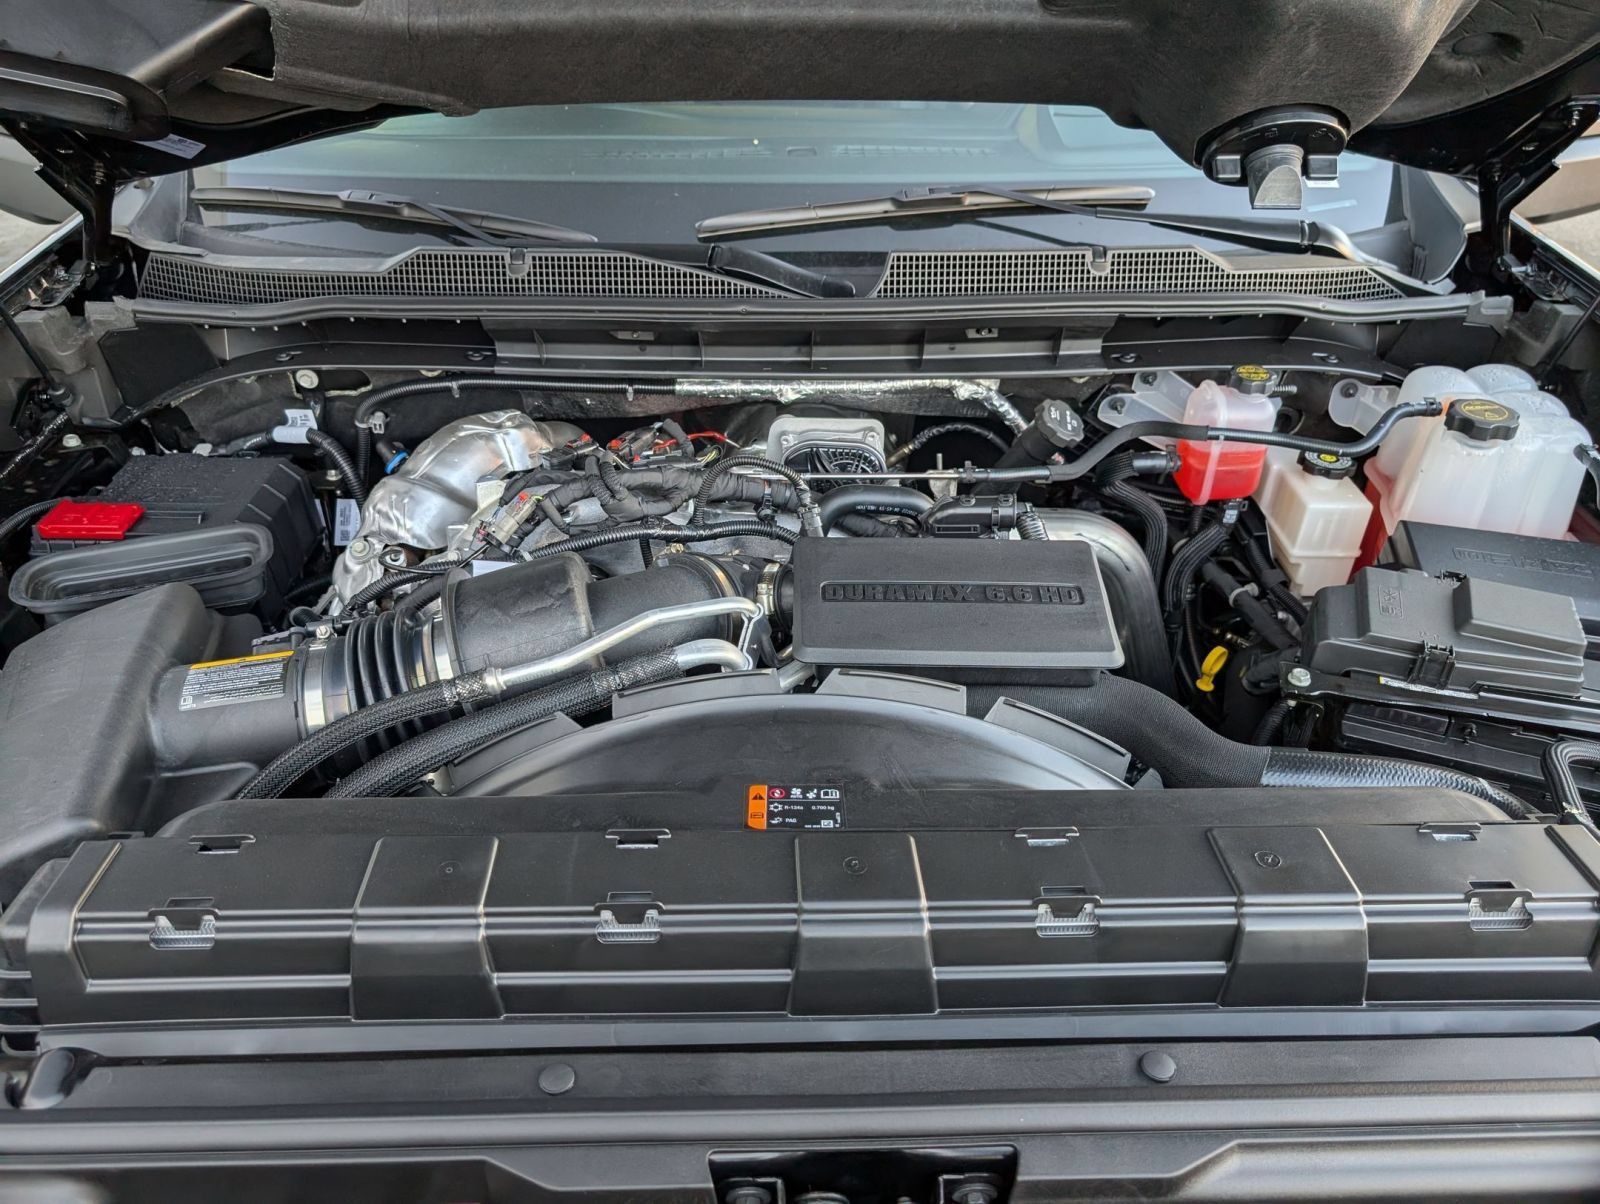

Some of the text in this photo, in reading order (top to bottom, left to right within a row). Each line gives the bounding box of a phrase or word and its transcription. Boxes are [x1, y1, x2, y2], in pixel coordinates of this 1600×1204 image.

[825, 583, 1081, 604] DURAMAX 6.6 HD
